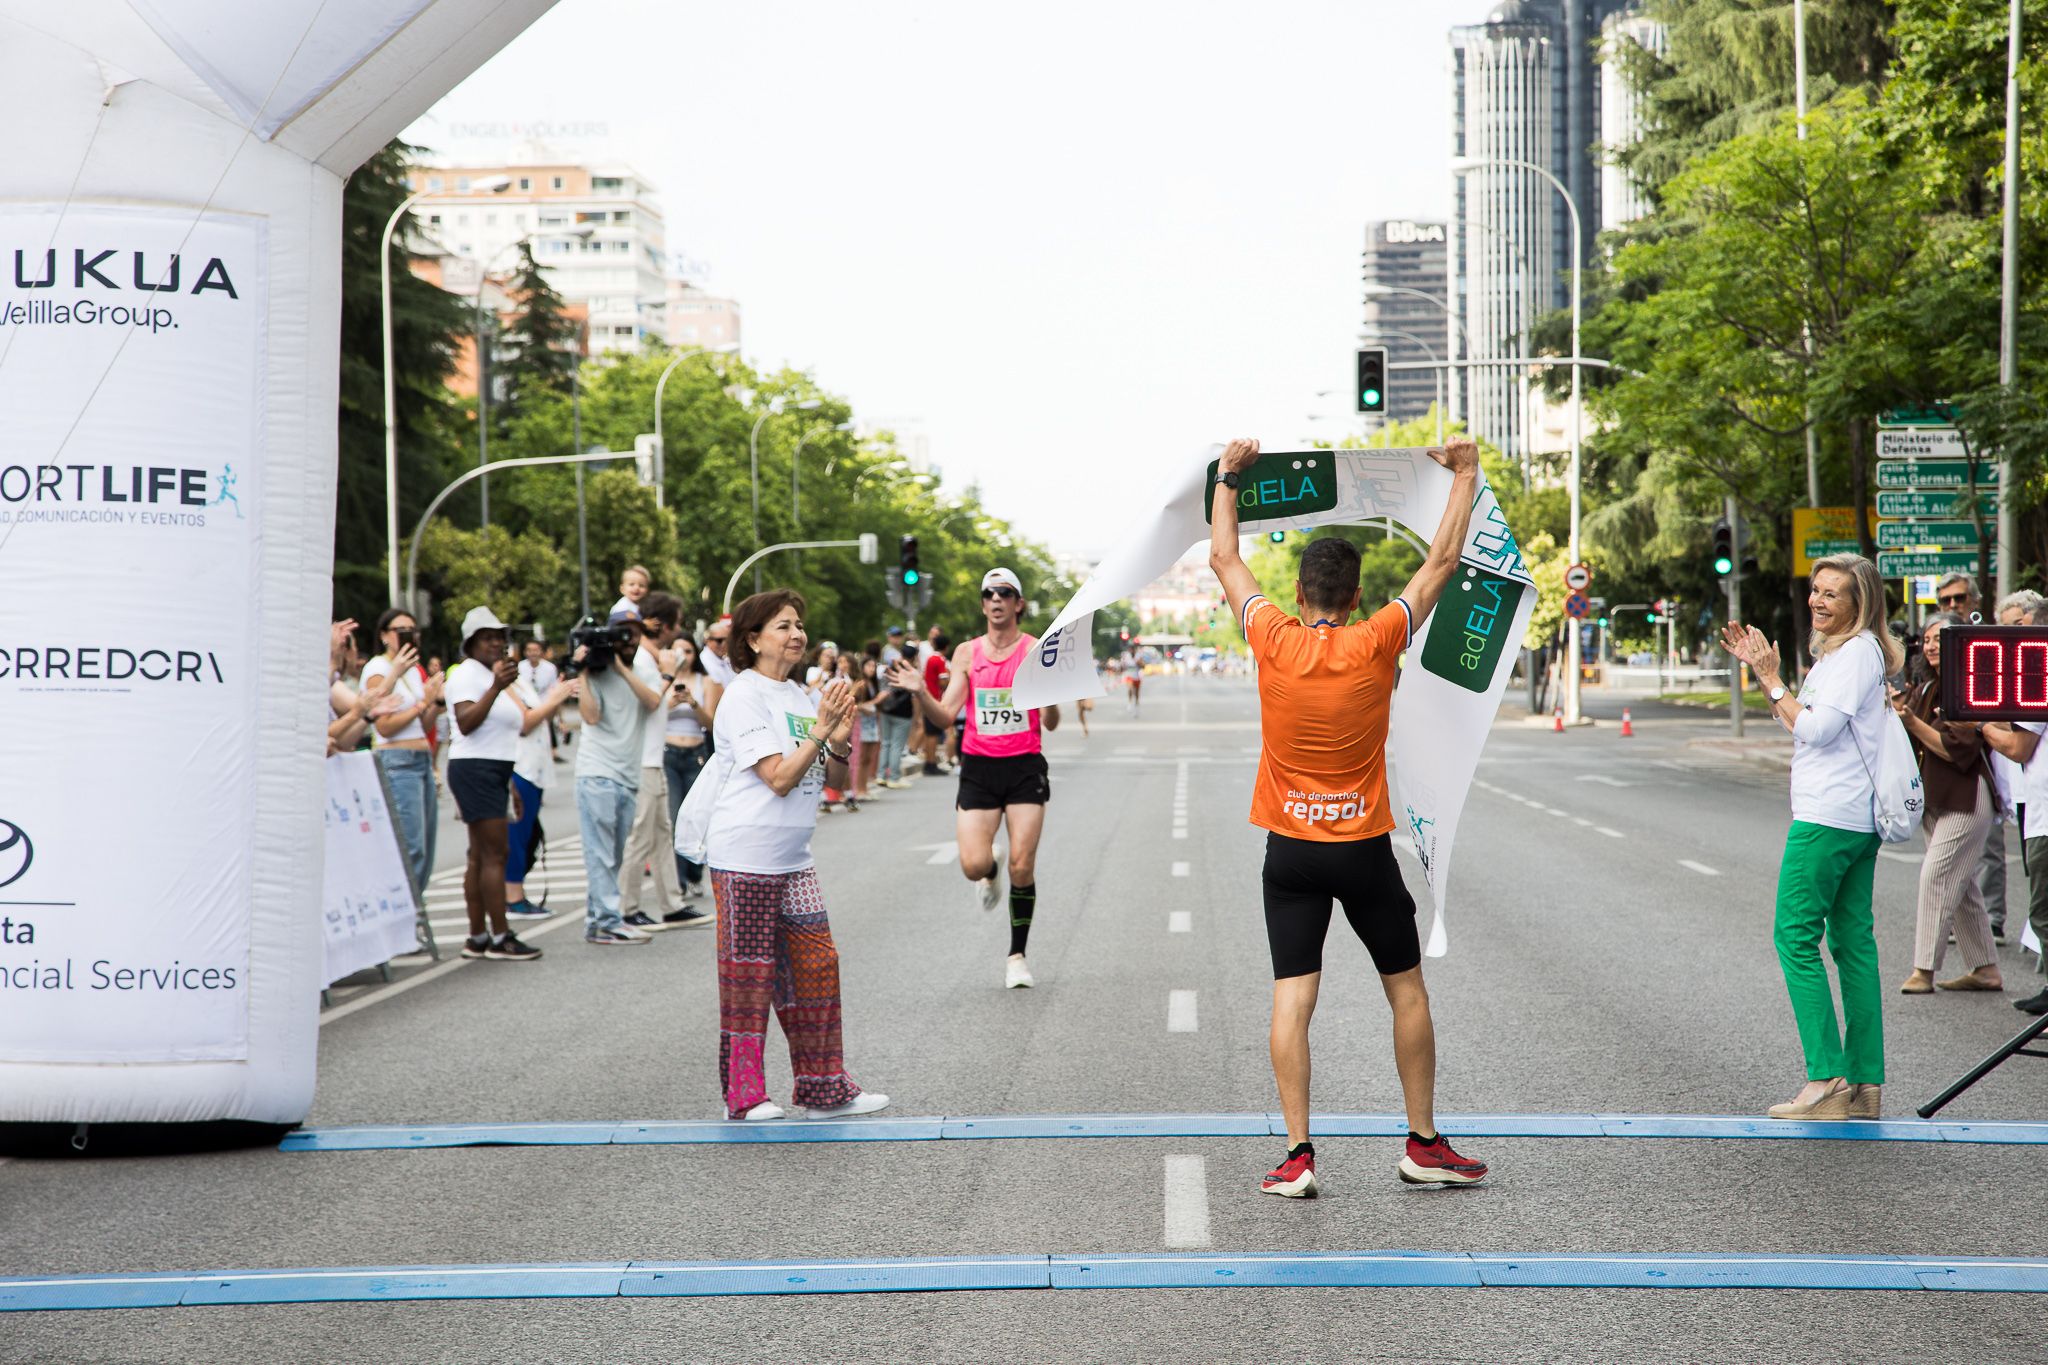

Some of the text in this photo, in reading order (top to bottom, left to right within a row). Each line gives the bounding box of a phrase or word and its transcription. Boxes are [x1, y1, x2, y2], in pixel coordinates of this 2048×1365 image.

[15, 248, 239, 300] UKUA
[1882, 434, 1943, 444] Ministerio
[1882, 444, 1931, 455] Defensa
[1881, 473, 1907, 484] San
[1882, 503, 1927, 513] Alberto
[129, 513, 138, 524] Y
[141, 513, 205, 527] EVENTOS
[1882, 534, 1916, 544] Padre
[1460, 580, 1508, 671] adELA
[982, 710, 1023, 725] 1795
[1287, 789, 1358, 802] club deportivo
[1283, 796, 1366, 826] repsol
[91, 960, 236, 990] Services
